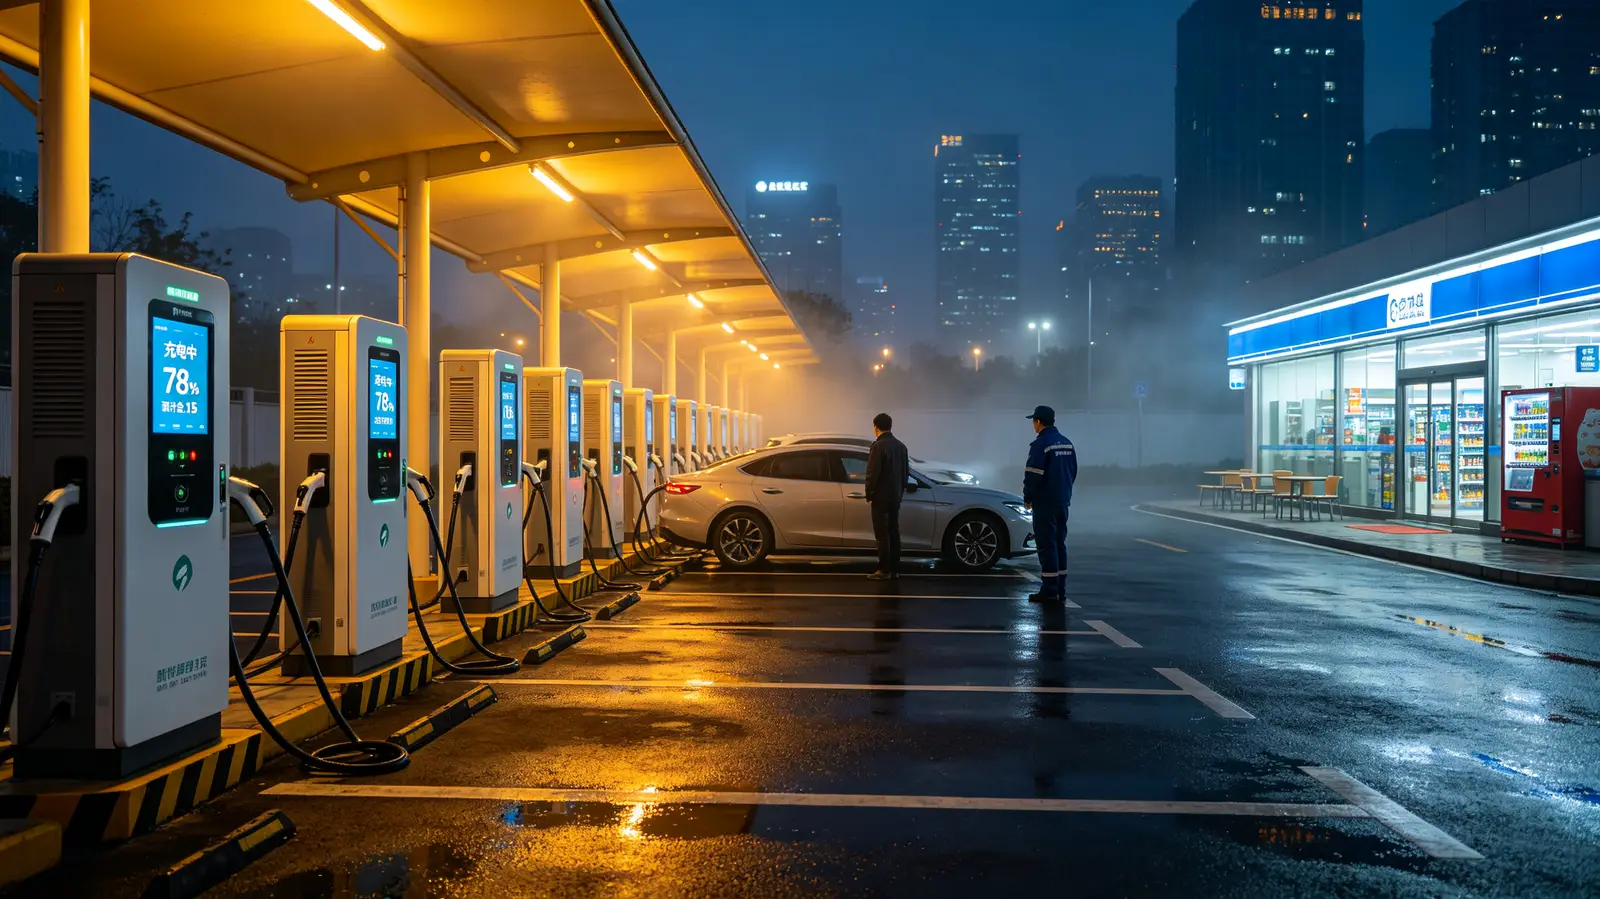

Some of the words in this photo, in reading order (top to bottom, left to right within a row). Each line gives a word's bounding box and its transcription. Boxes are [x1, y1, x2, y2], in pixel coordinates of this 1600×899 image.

[164, 341, 198, 360] 充电中
[163, 367, 199, 395] 78%
